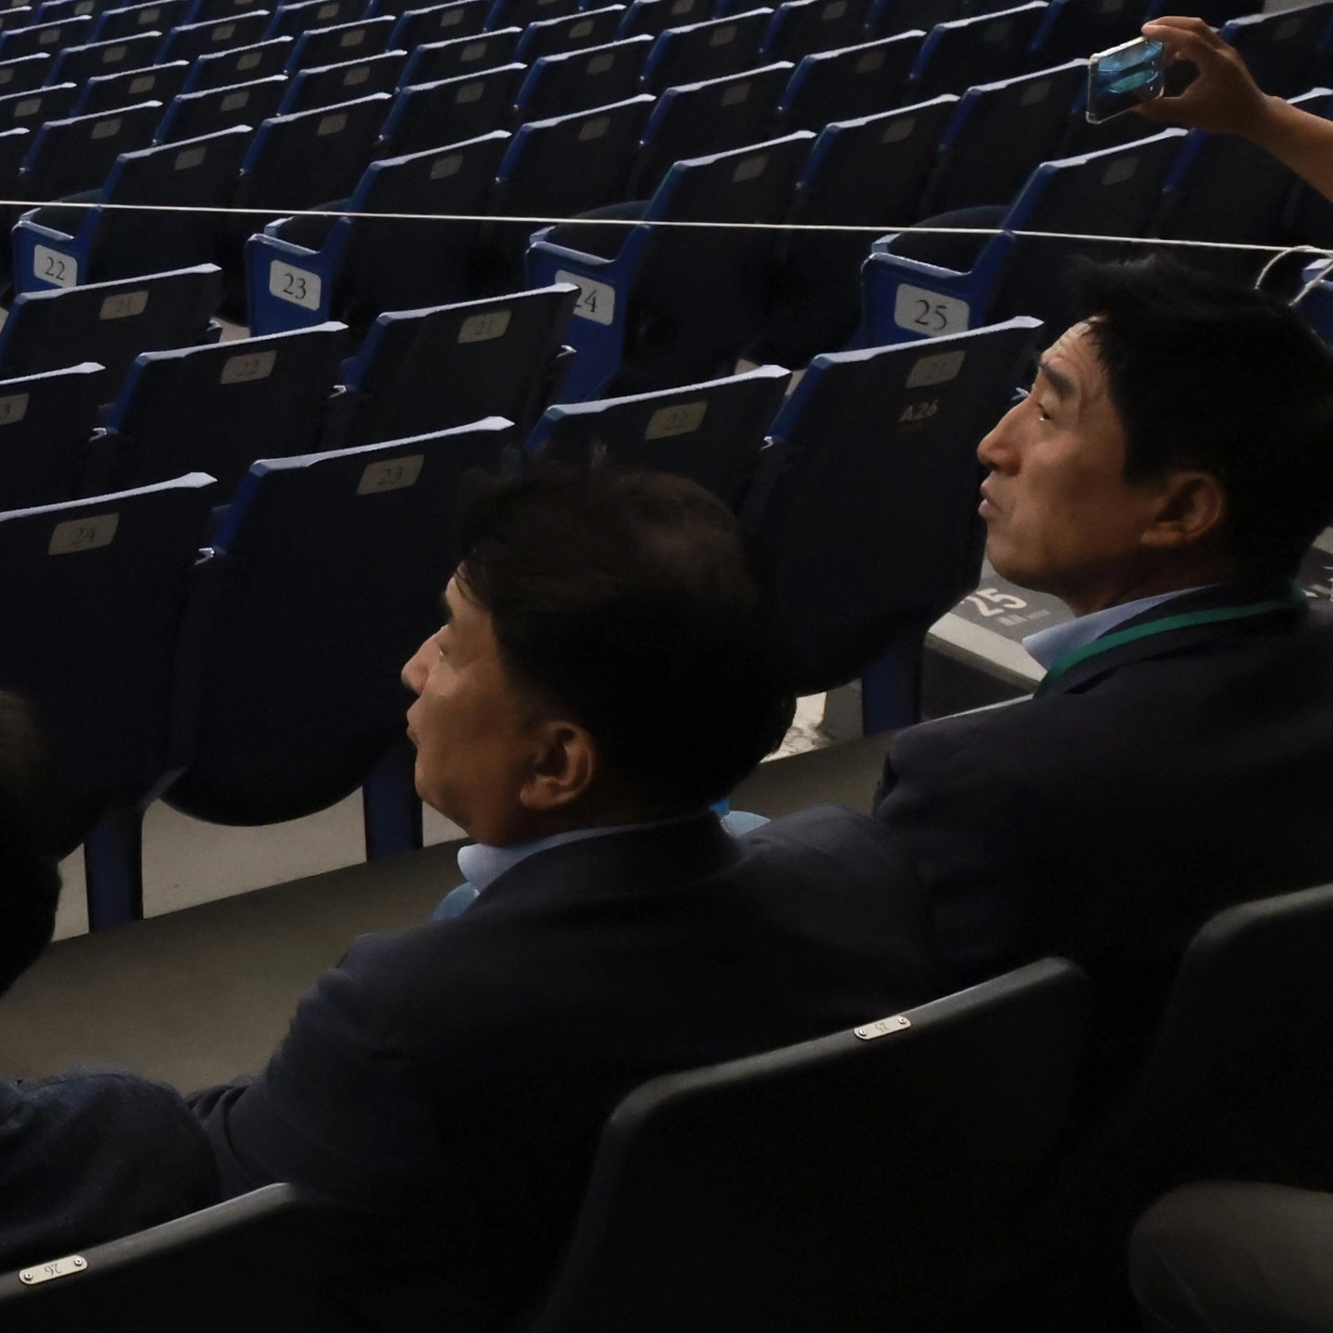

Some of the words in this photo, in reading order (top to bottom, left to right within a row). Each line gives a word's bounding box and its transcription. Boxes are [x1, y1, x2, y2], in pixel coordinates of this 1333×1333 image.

[45, 257, 65, 280] 22
[283, 274, 307, 299] 23
[914, 300, 946, 330] 25
[237, 360, 258, 376] 22
[900, 399, 939, 423] A26
[380, 467, 403, 486] 23
[72, 526, 95, 546] 24
